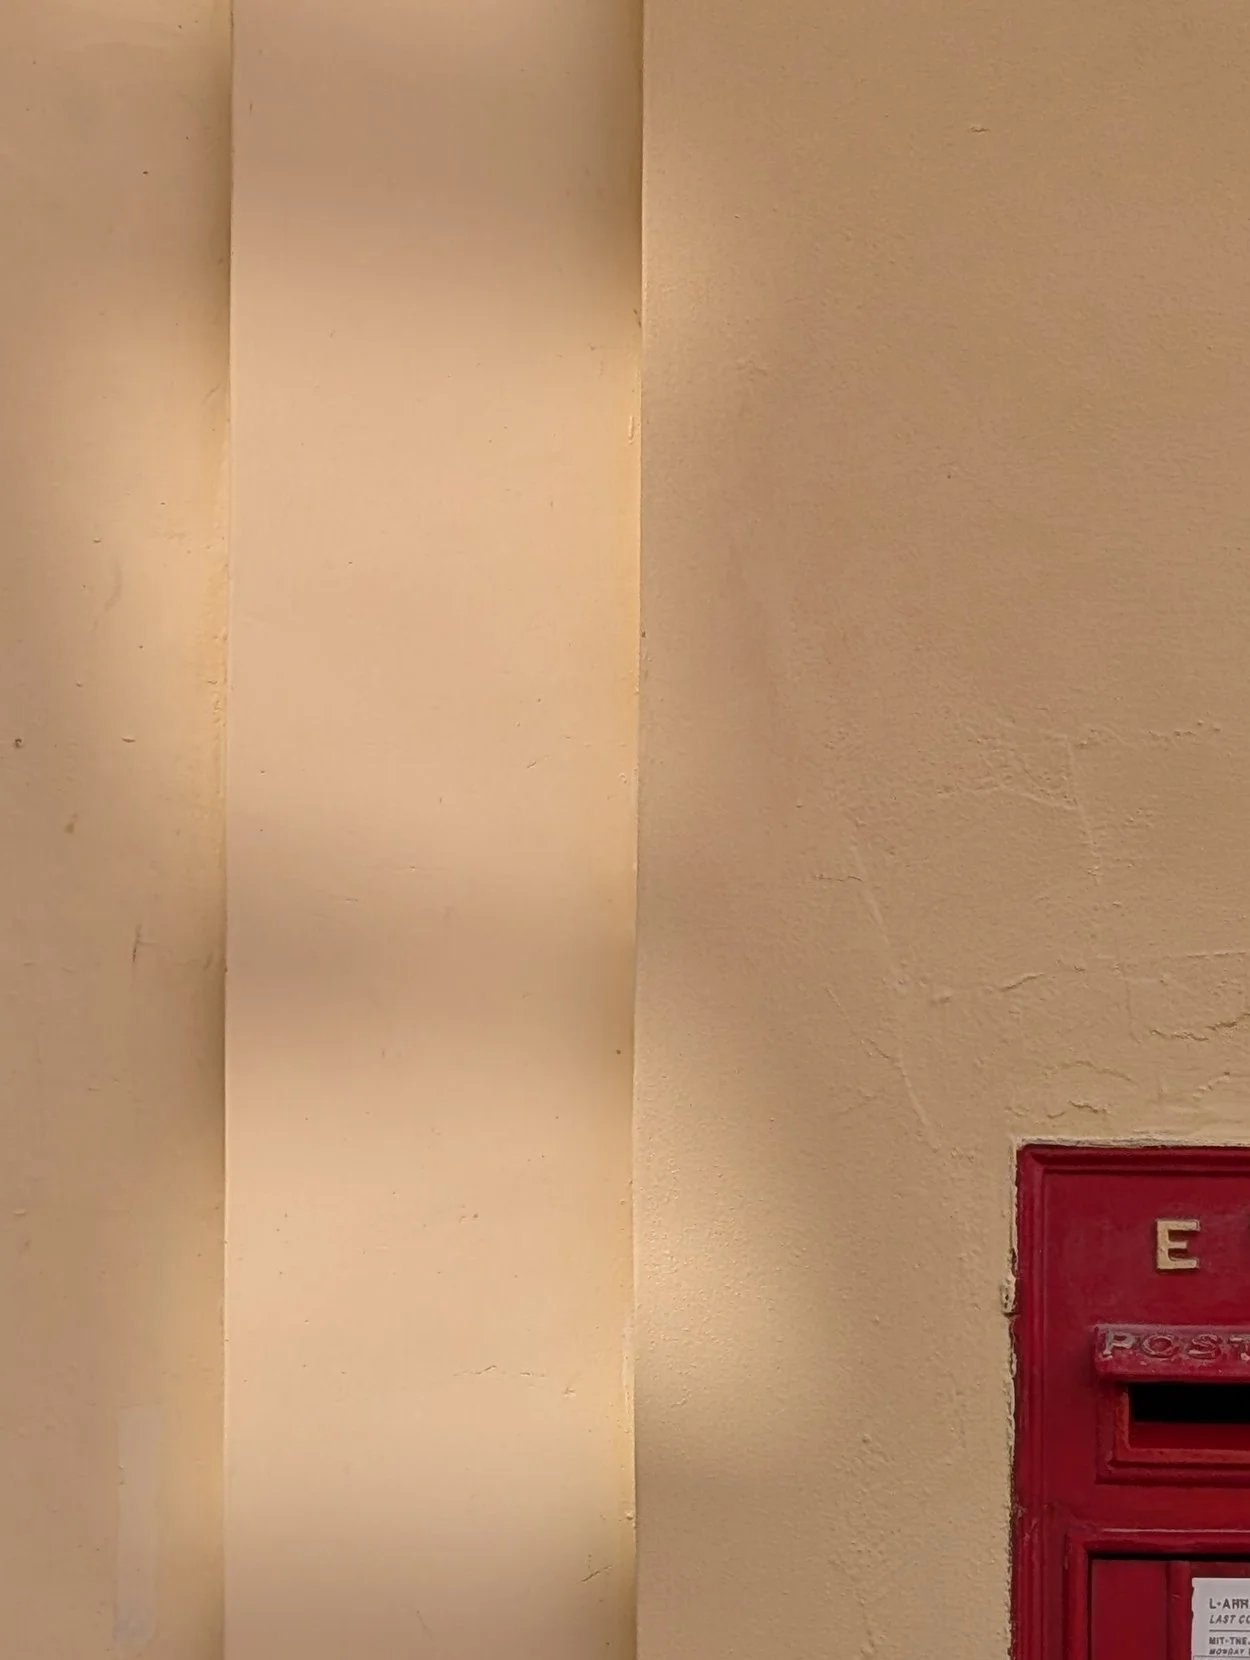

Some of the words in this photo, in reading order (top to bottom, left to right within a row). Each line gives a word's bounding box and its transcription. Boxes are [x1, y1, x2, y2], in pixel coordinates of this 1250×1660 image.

[1154, 1217, 1200, 1271] E
[1208, 1614, 1237, 1625] LAST
[1208, 1648, 1246, 1656] MONDAY
